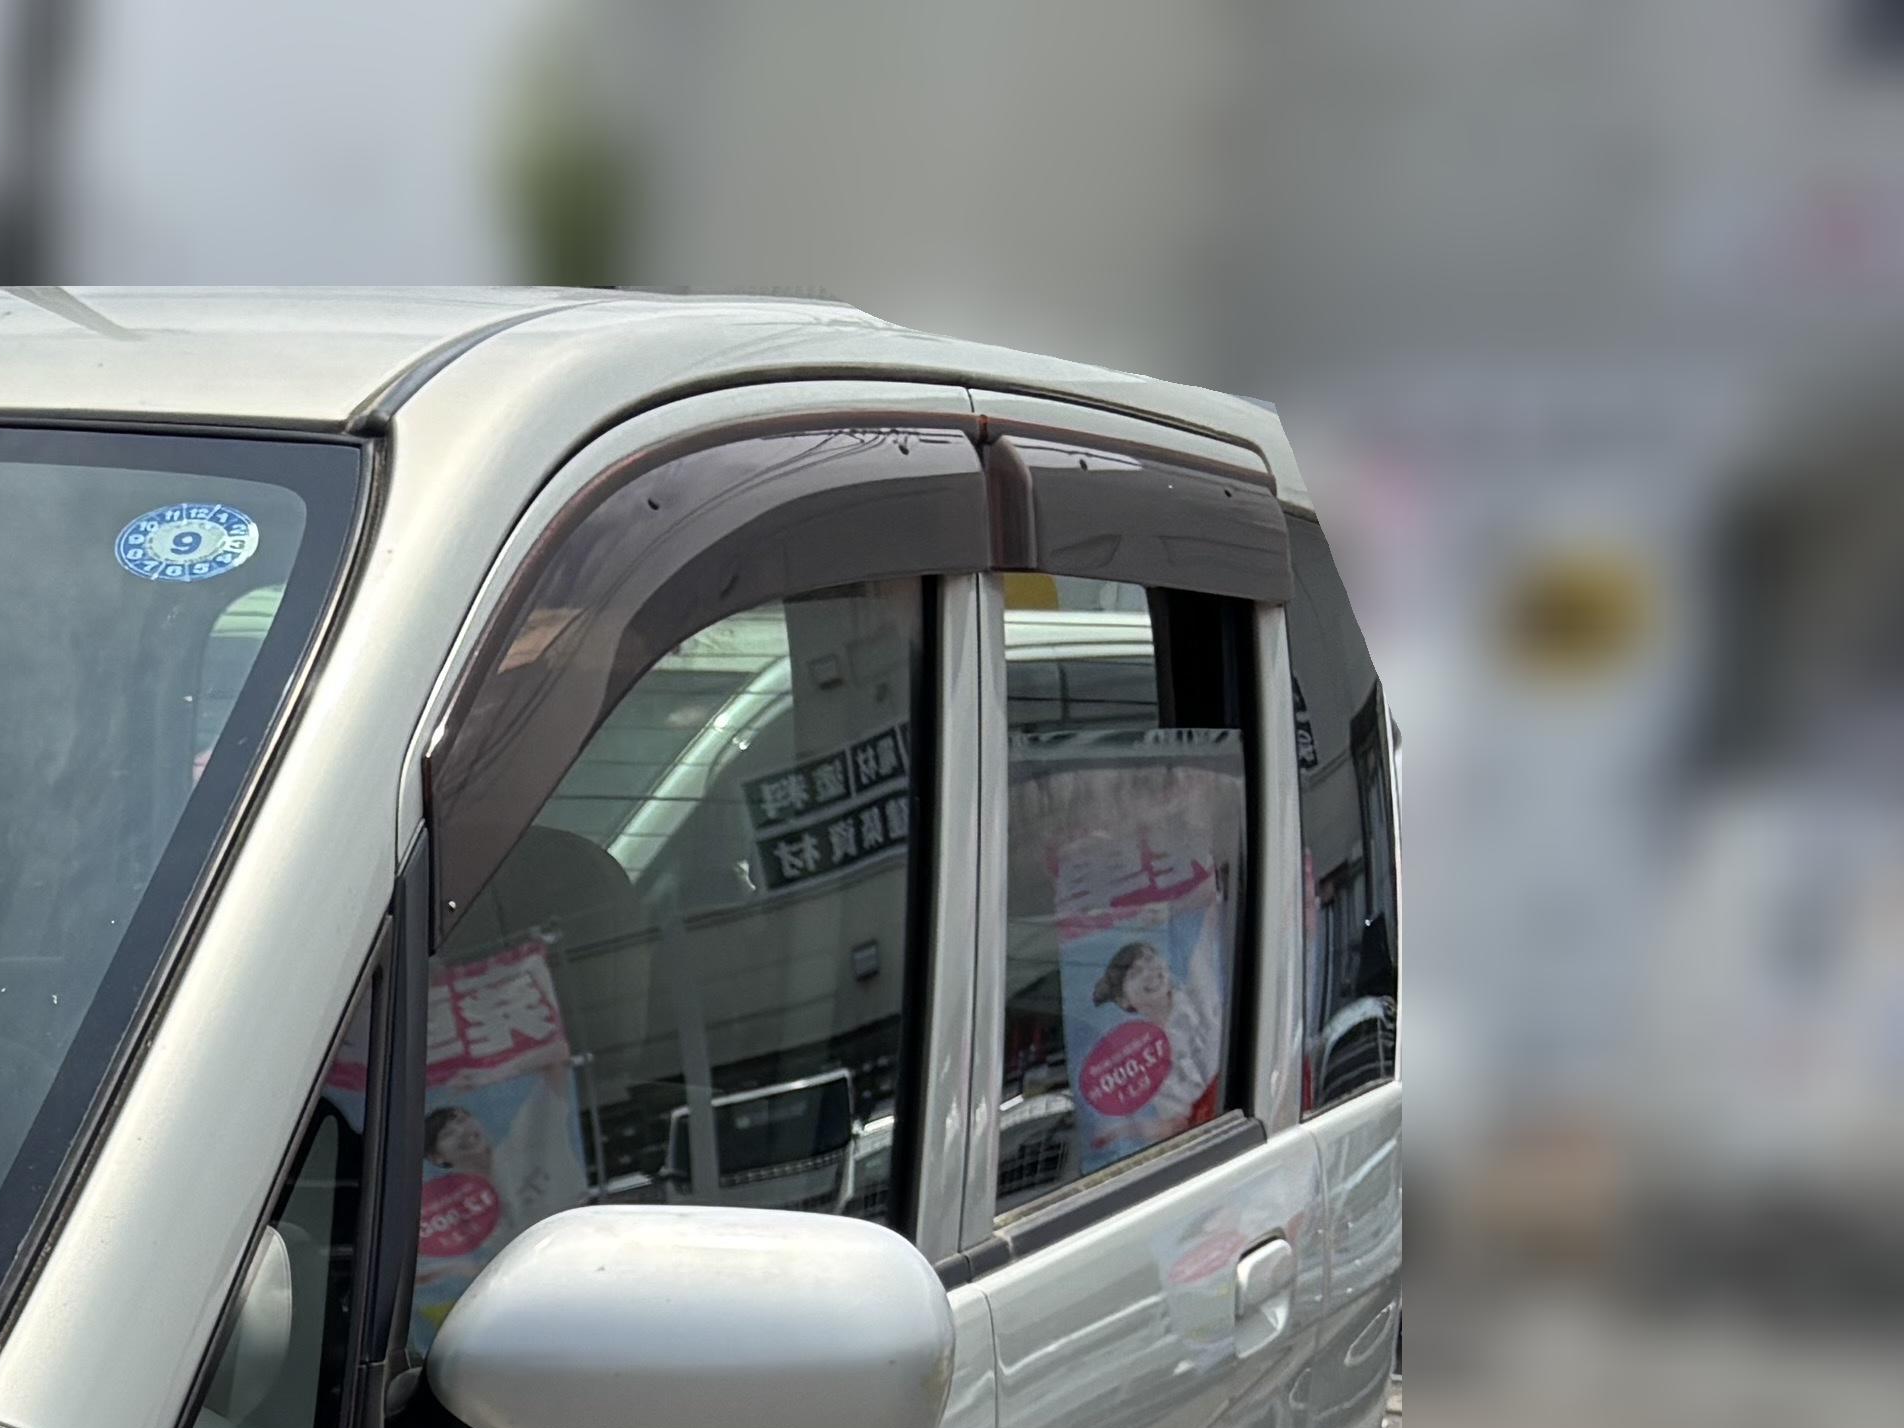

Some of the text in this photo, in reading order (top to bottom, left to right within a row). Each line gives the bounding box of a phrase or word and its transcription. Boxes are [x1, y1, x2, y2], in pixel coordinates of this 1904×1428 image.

[188, 508, 208, 521] 12
[139, 520, 159, 533] 10
[128, 533, 145, 546] 9
[170, 531, 202, 555] 9
[126, 548, 144, 561] 8
[142, 560, 159, 572] 7
[165, 565, 184, 577] 6
[192, 561, 211, 575] 5
